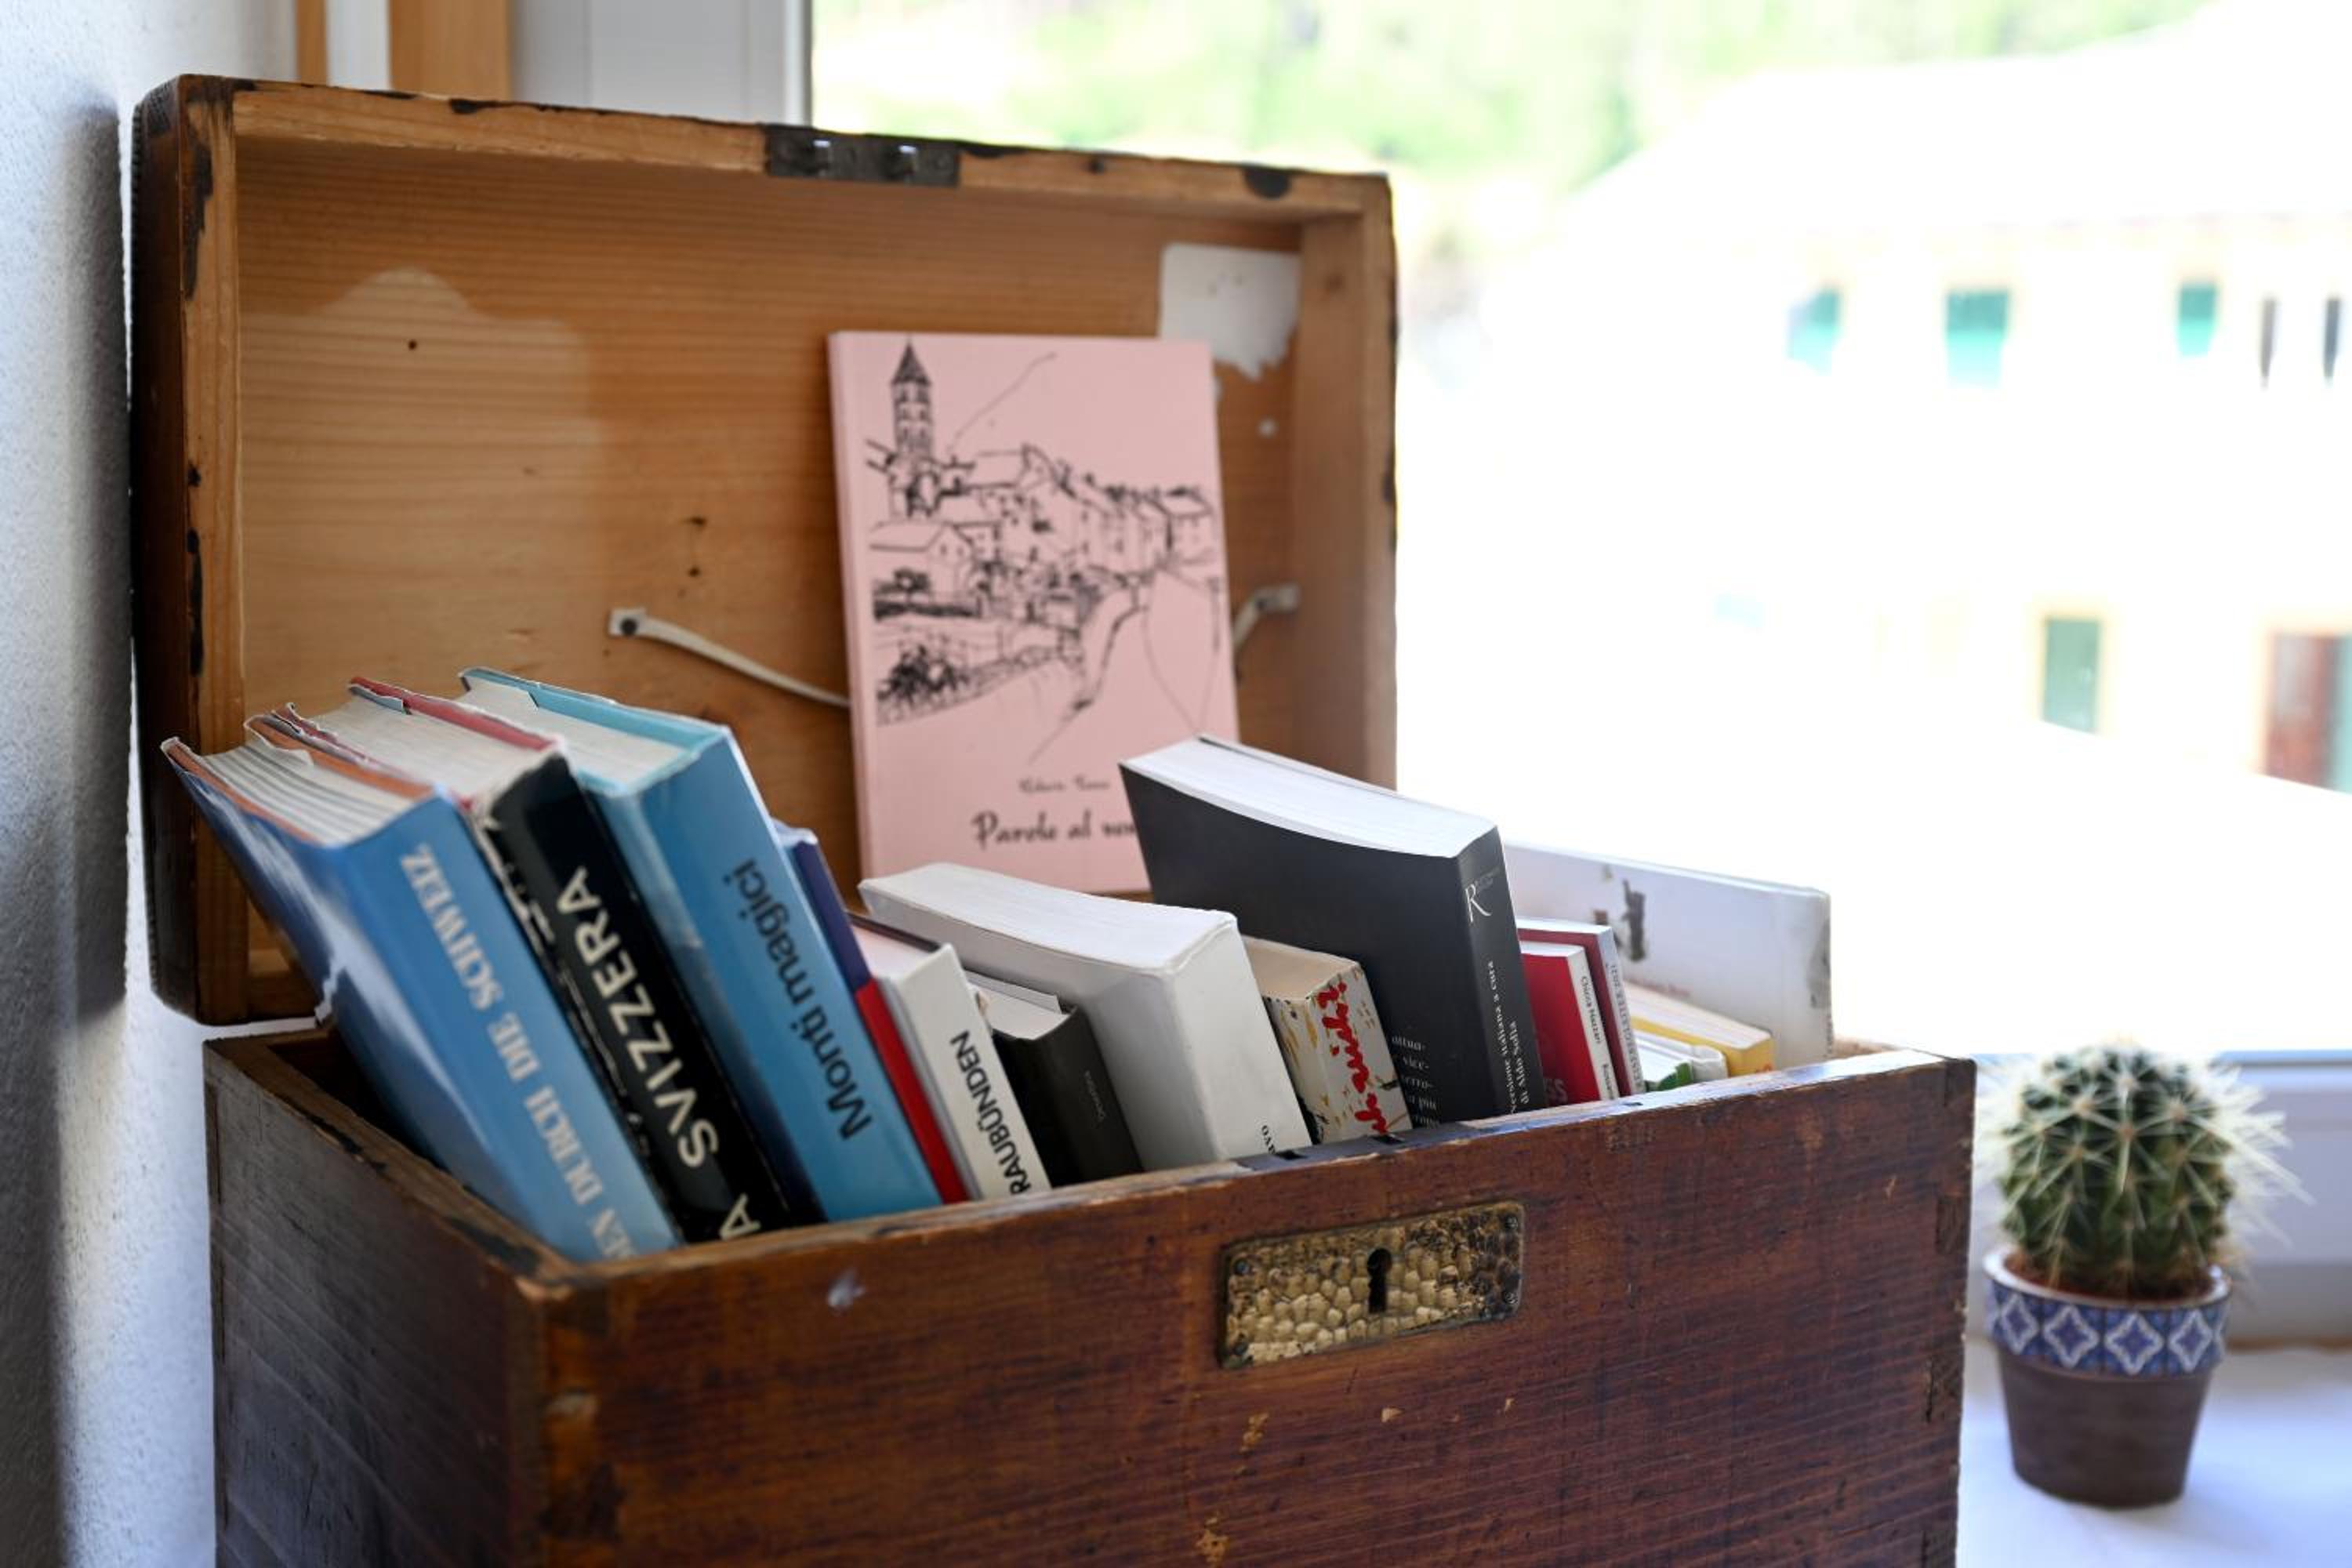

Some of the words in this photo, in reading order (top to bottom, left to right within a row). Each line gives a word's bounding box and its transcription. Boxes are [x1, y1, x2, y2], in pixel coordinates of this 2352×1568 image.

[1066, 809, 1092, 841] al
[400, 842, 503, 1011] SCHWEIZ
[722, 858, 815, 1007] magici
[486, 1010, 543, 1083] DIE
[556, 866, 720, 1169] SVIZZERA
[789, 1003, 873, 1142] Monti
[523, 1084, 604, 1207] DURCH
[949, 1029, 1032, 1196] RAUBÜNDEN
